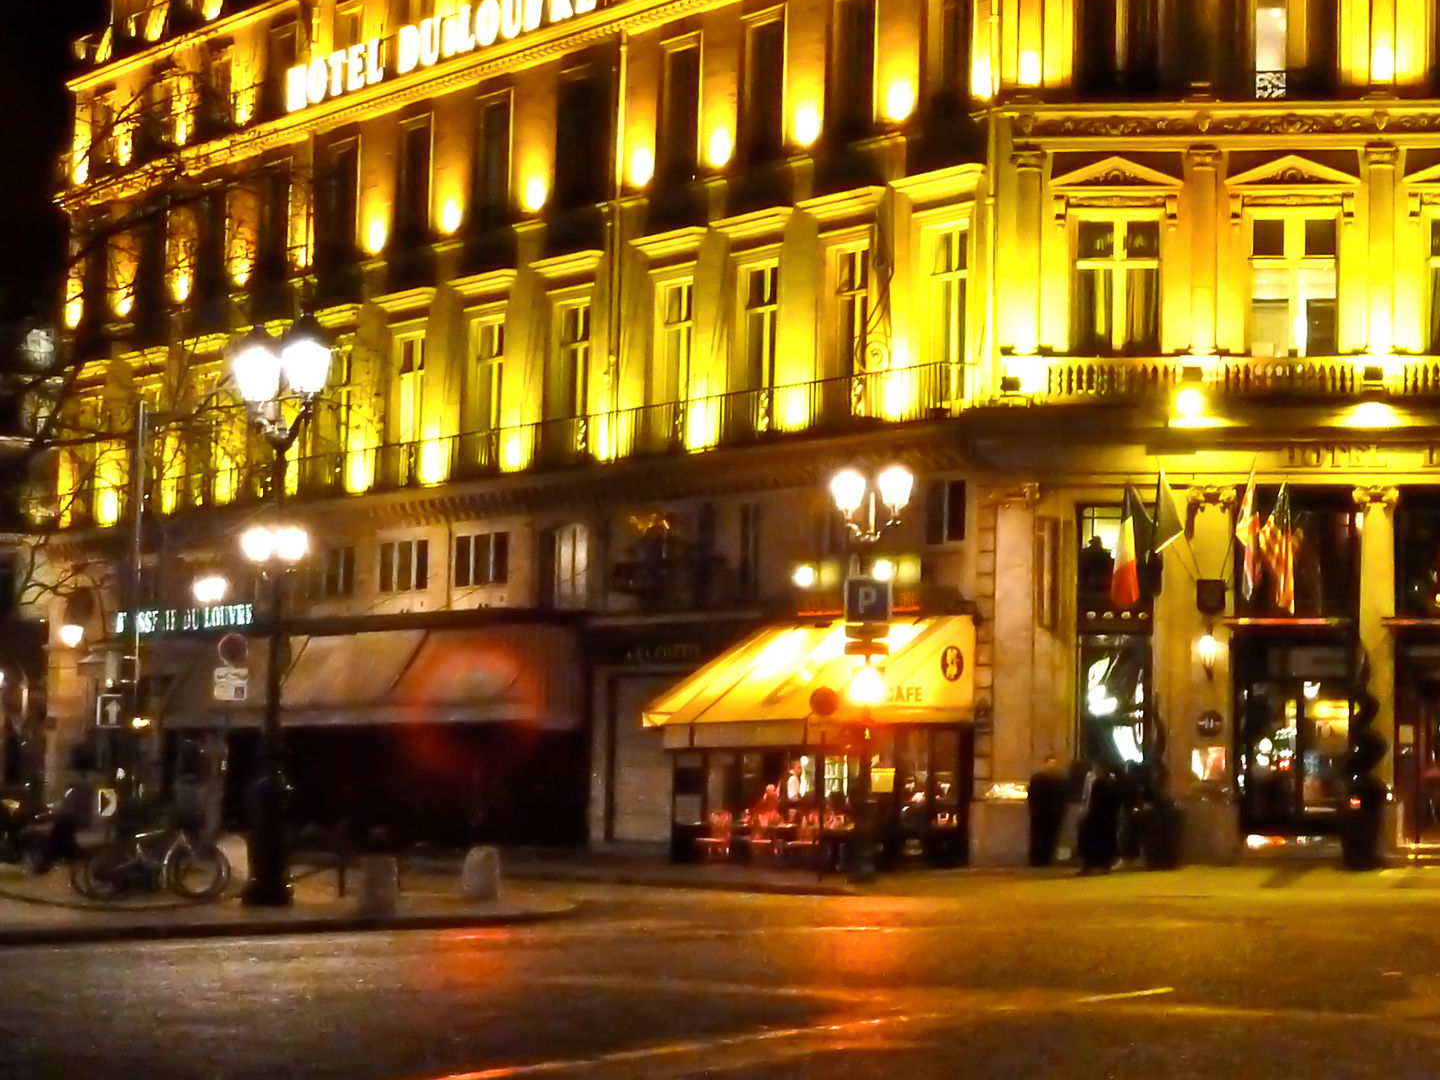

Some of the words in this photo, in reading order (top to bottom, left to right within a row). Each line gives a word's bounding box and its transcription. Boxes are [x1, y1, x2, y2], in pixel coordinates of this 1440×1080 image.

[285, 37, 385, 113] HOTEL
[397, 16, 442, 74] DU
[858, 586, 877, 614] P
[114, 609, 178, 634] BSSEIE
[203, 603, 254, 629] LOUVRE
